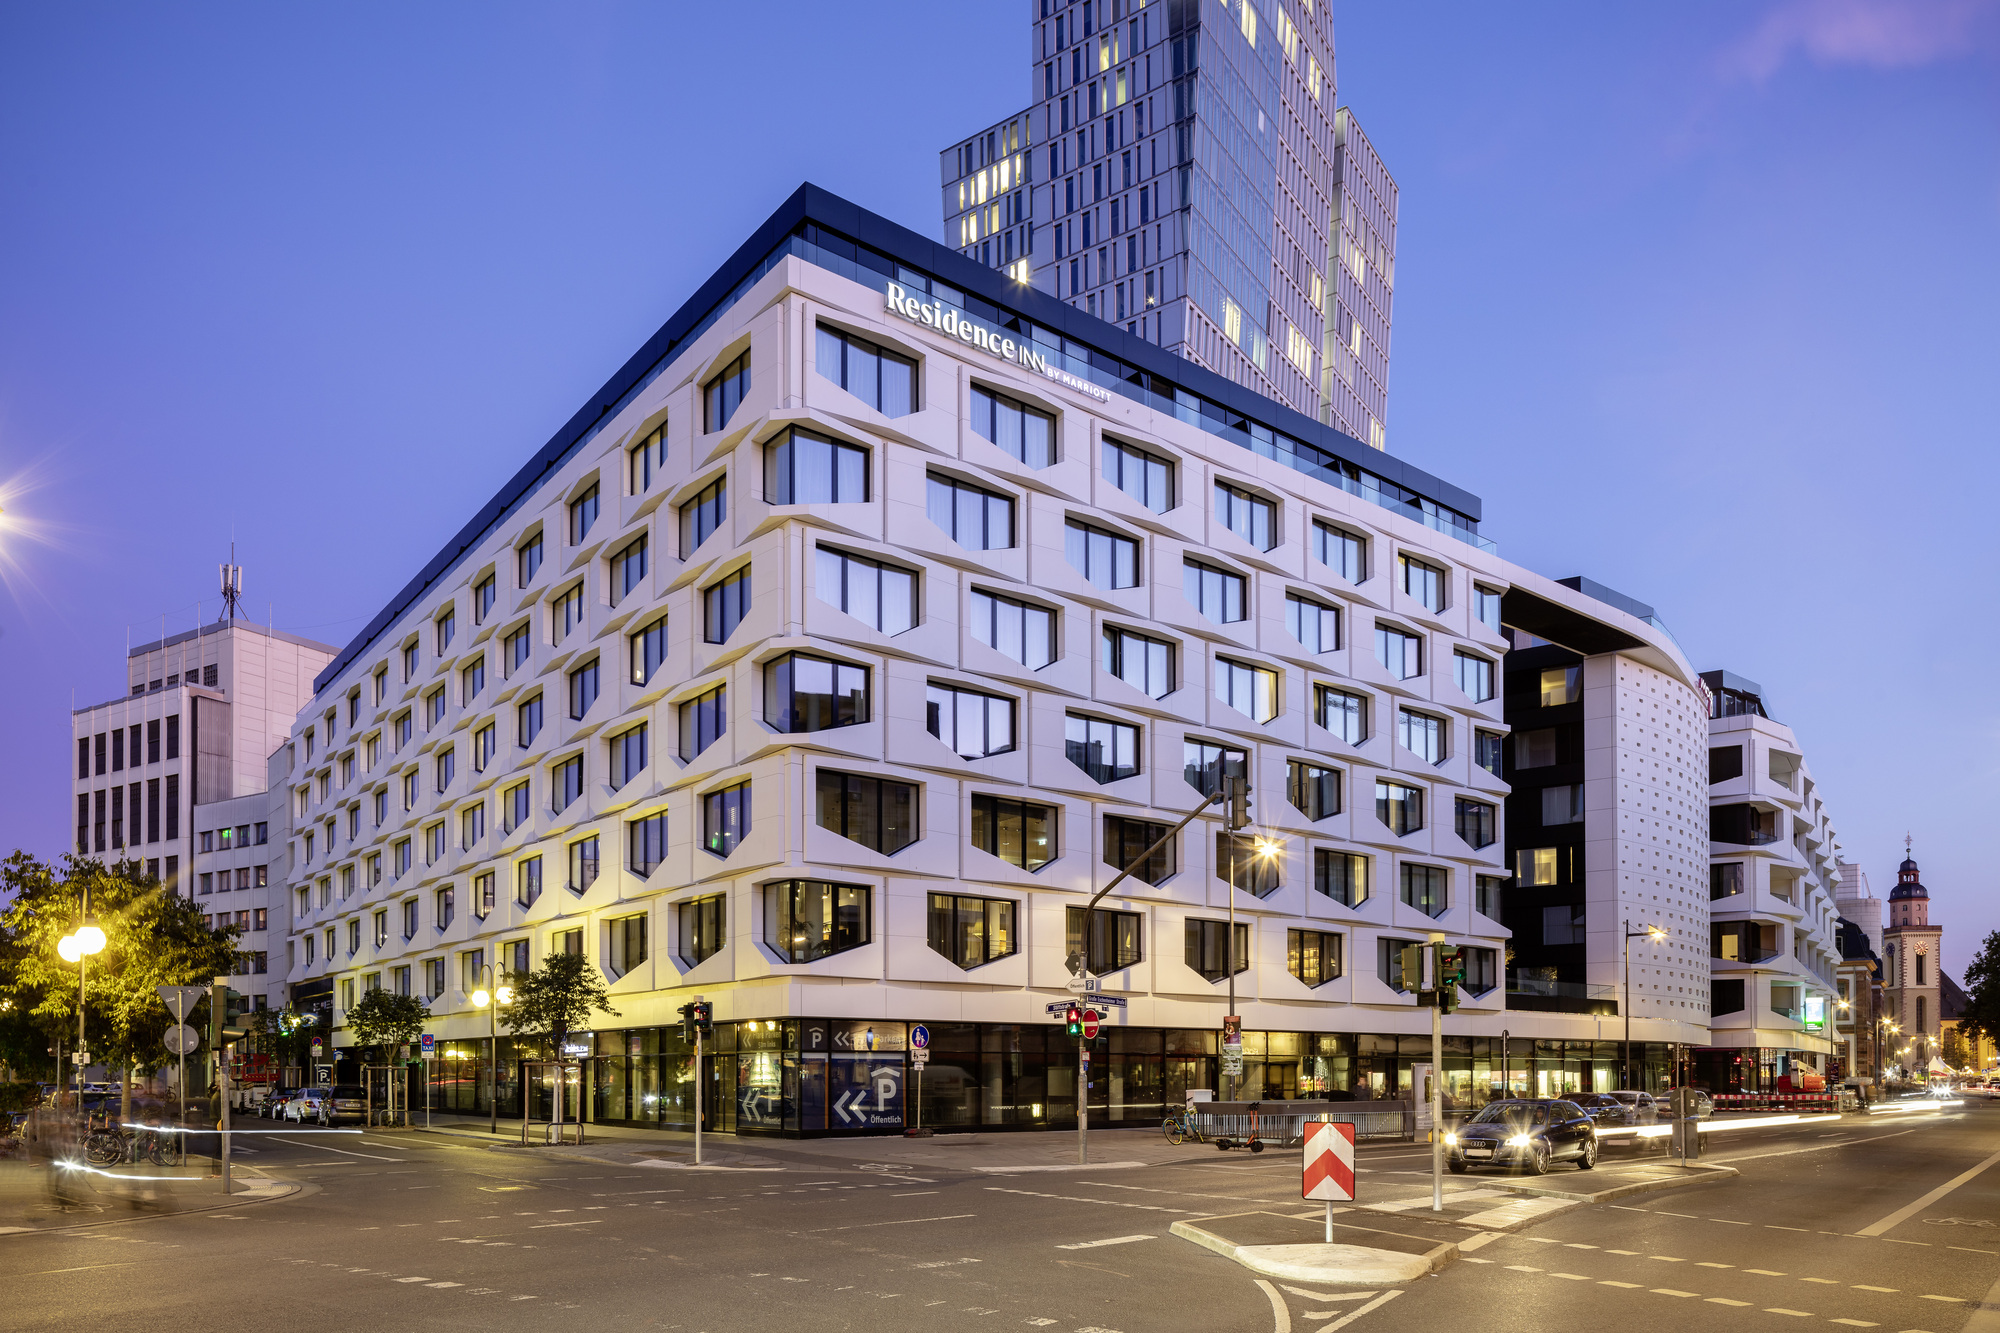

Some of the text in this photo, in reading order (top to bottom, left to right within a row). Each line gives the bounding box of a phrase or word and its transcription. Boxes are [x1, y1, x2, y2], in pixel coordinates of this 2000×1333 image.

[886, 281, 1045, 374] Residence INN
[1047, 367, 1112, 402] BY MARRIOTT
[878, 1078, 897, 1112] P
[870, 1115, 902, 1124] Öffentlich
